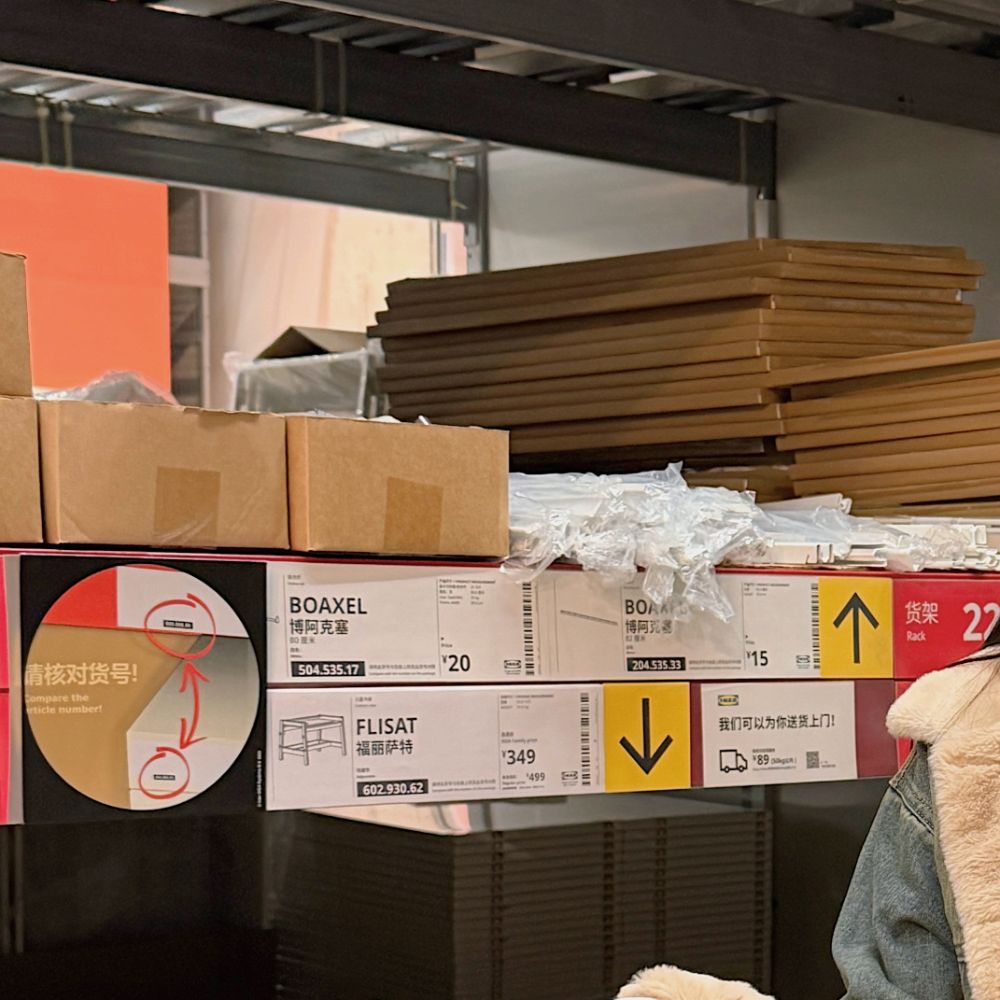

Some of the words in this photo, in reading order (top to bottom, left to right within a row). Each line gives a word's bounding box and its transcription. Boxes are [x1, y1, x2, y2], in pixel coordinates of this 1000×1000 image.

[289, 596, 368, 615] BOAXEL
[905, 600, 939, 624] 货架
[289, 618, 349, 635] 博阿克塞
[907, 631, 926, 641] Rack
[441, 654, 471, 673] ¥20
[632, 659, 682, 671] 204.535.33
[746, 650, 769, 667] ¥15
[25, 662, 138, 687] 请核对货号!
[298, 663, 359, 676] 504.535.17
[71, 694, 90, 702] the
[58, 705, 103, 714] number!
[356, 717, 417, 735] FLISAT
[719, 714, 836, 731] 我们可以为你送货上门!
[356, 739, 413, 756] 福丽萨特
[502, 749, 536, 765] ¥349
[753, 754, 769, 765] ¥89
[363, 782, 424, 796] 602.930.62
